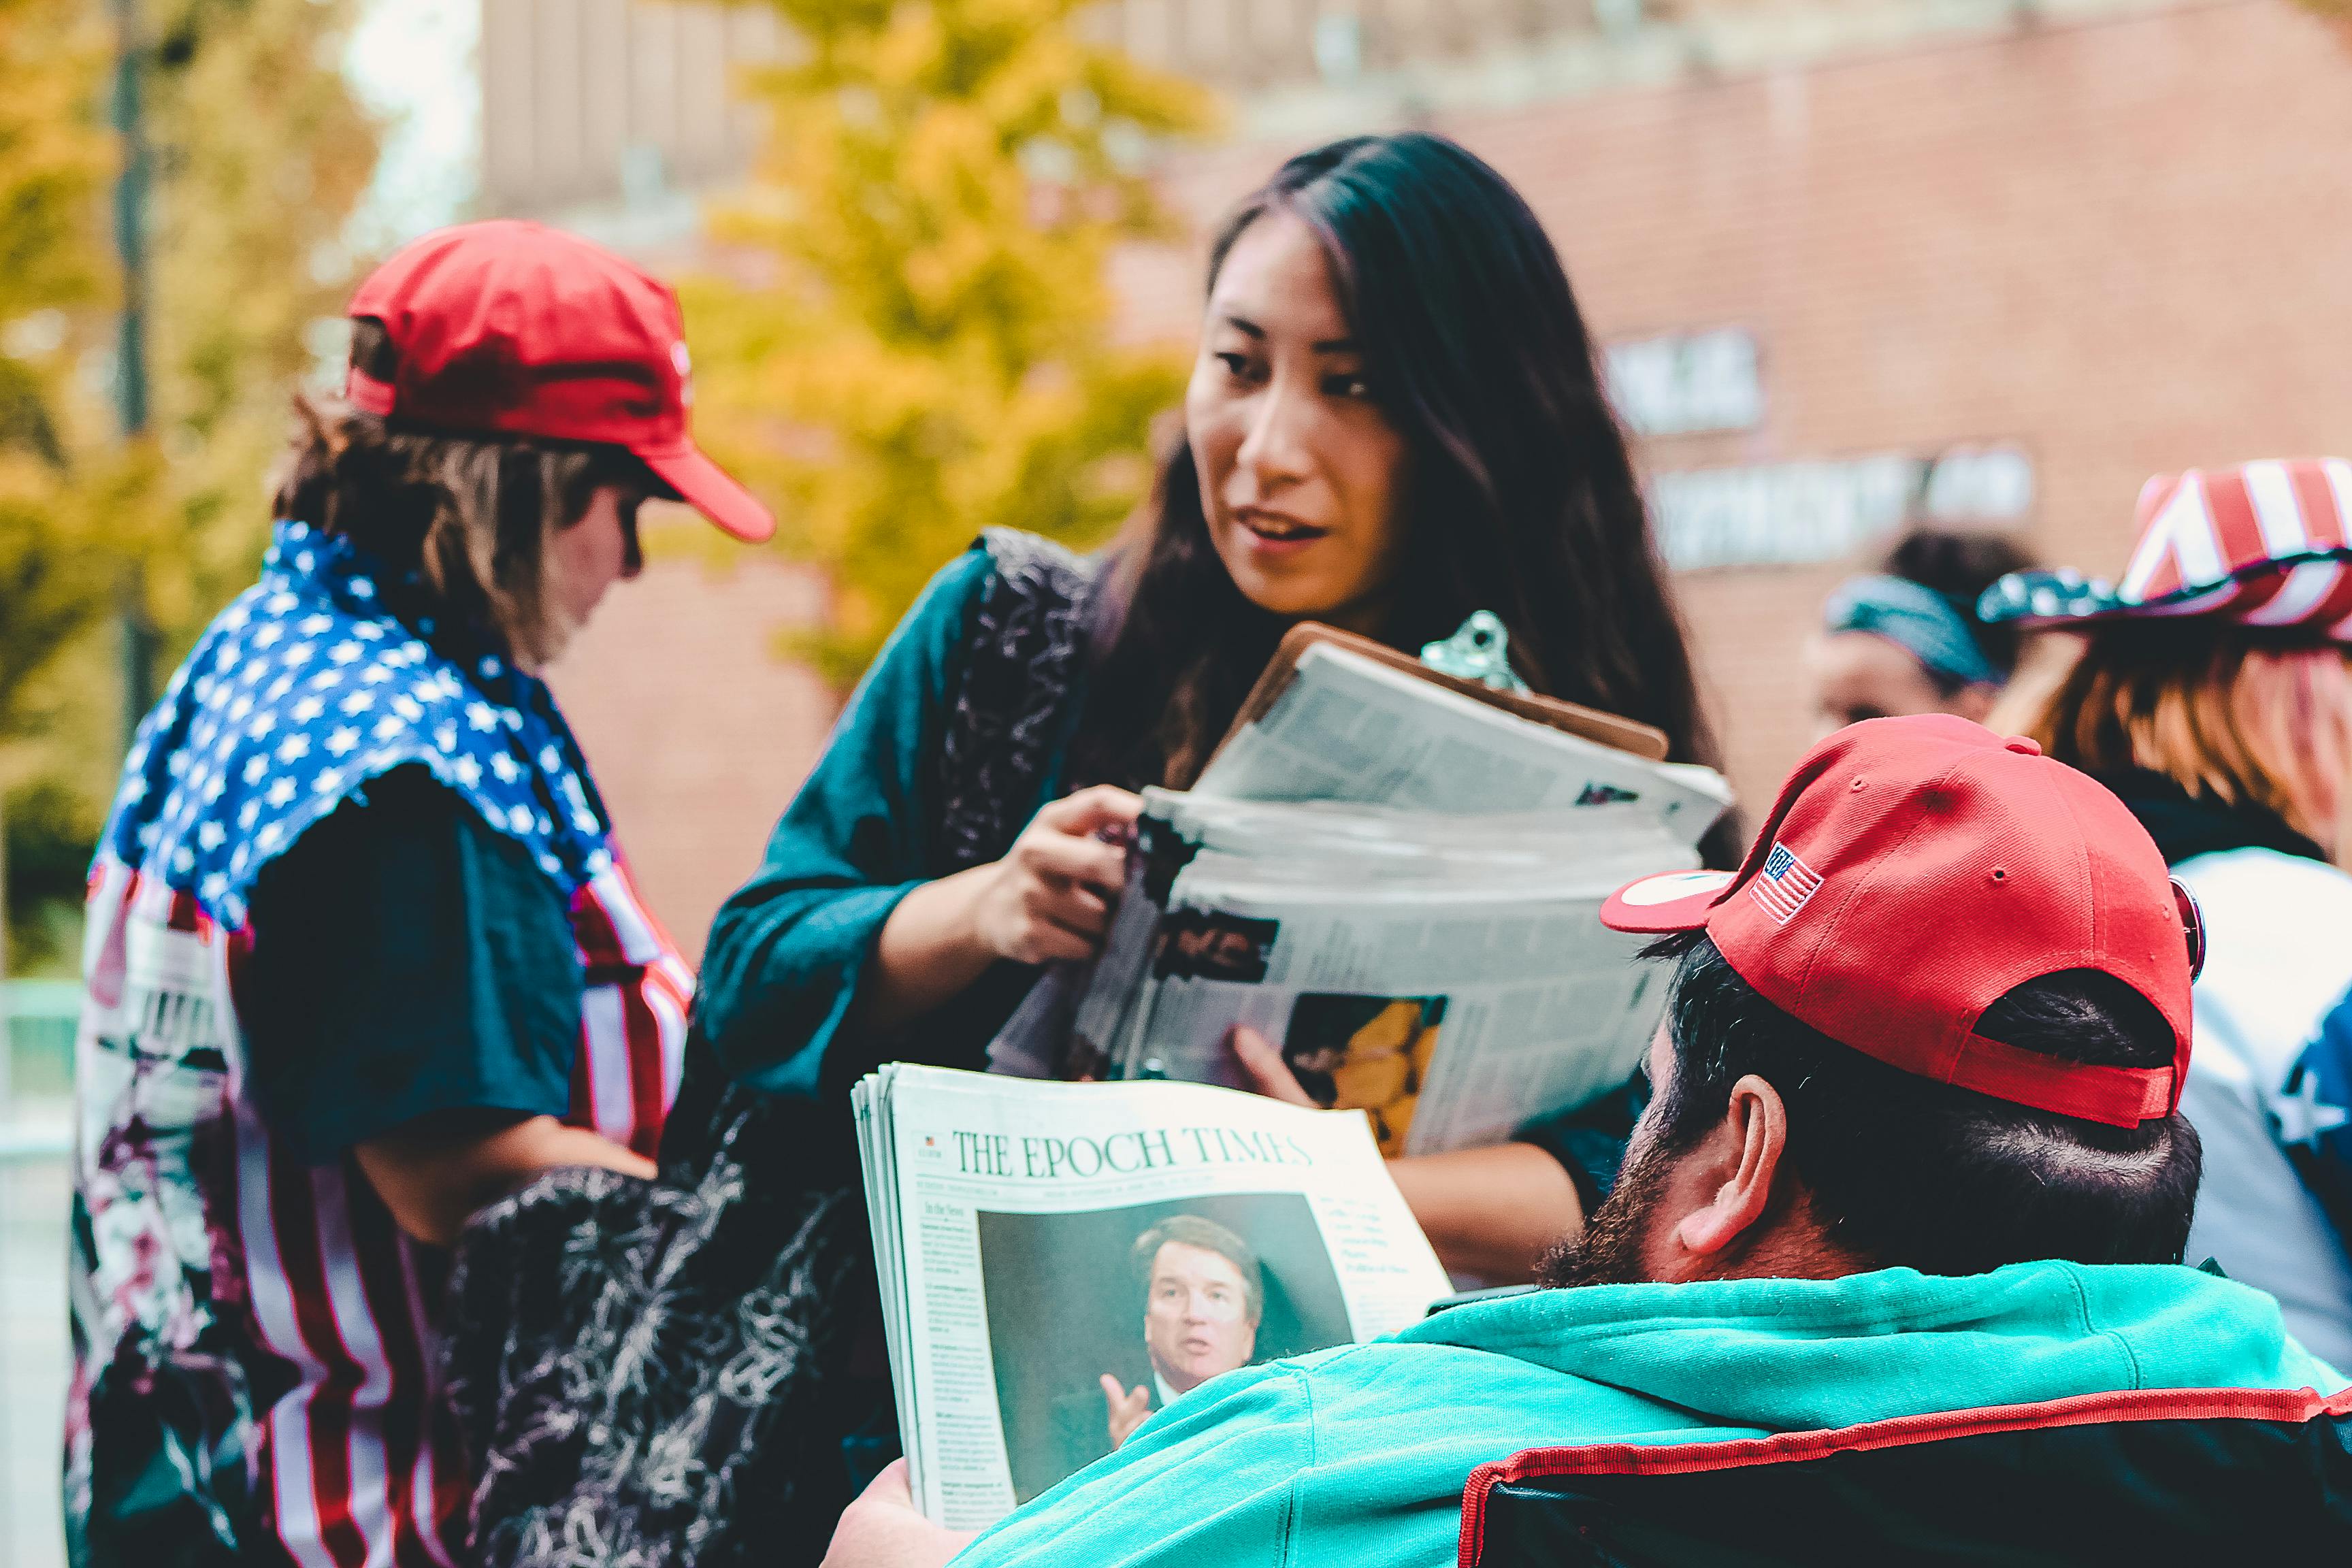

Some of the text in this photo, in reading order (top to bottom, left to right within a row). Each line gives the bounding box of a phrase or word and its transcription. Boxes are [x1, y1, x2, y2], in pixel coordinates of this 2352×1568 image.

[952, 1127, 1313, 1178] THE EPOCH TIMES
